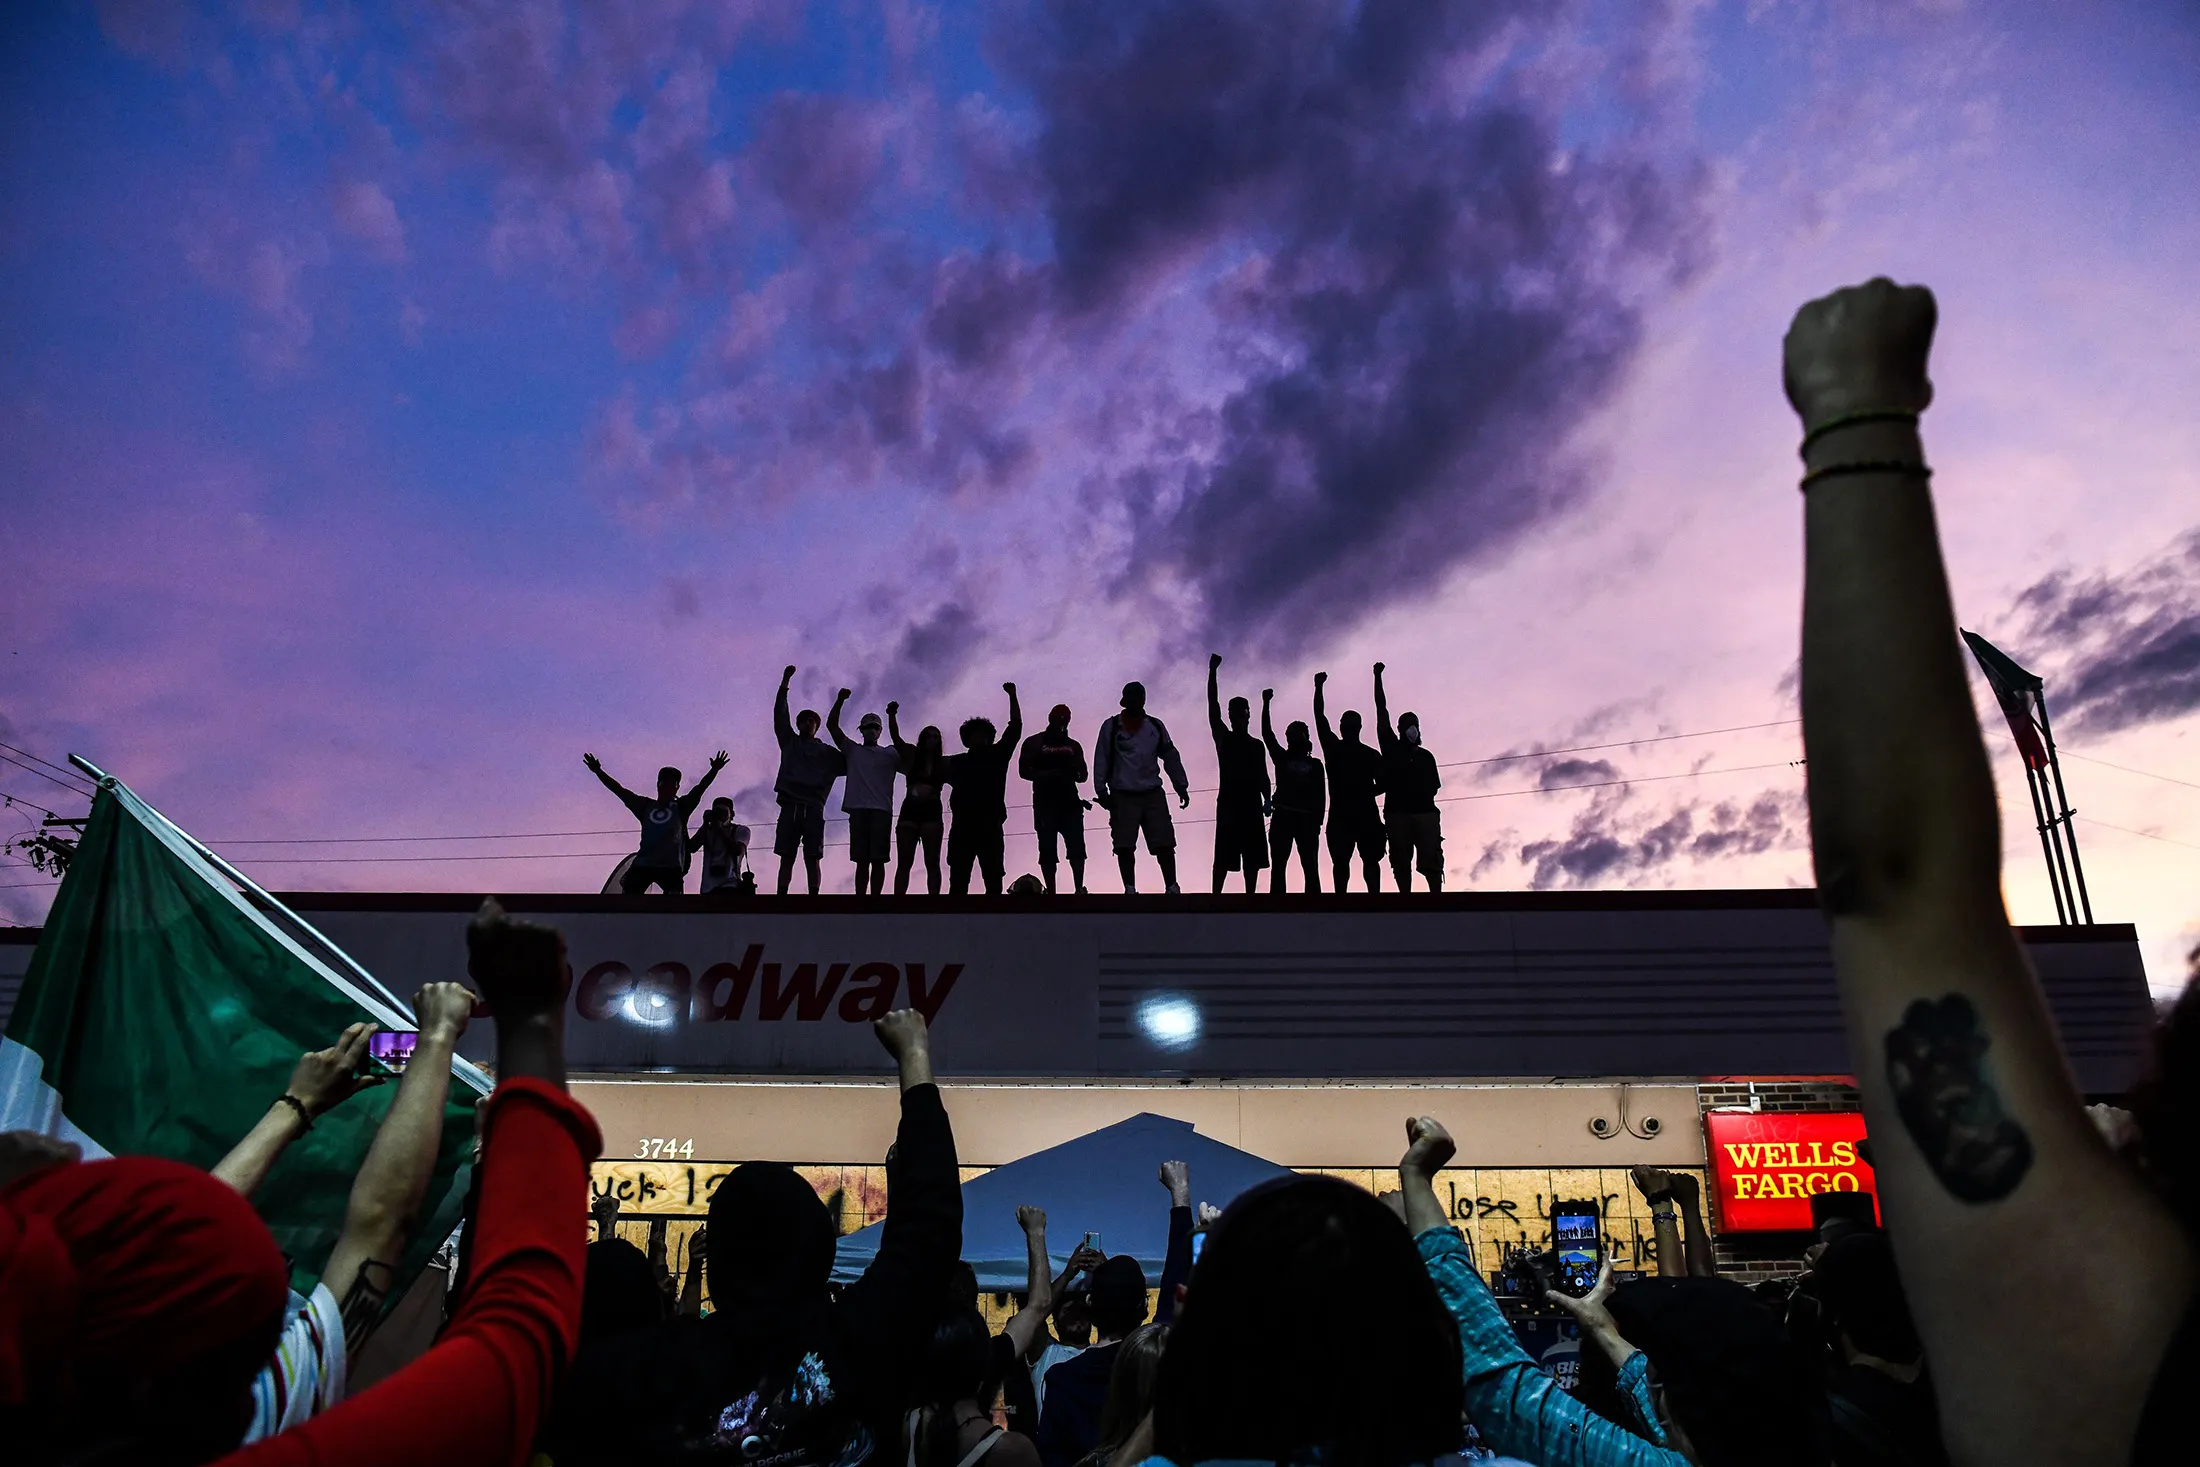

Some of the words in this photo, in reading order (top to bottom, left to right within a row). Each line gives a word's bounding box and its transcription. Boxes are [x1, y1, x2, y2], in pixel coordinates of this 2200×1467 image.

[470, 943, 966, 1029] eedway
[633, 1138, 695, 1160] 3744
[1723, 1141, 1856, 1168] WELLS
[588, 1172, 657, 1203] uck
[1731, 1171, 1860, 1199] FARGO
[1449, 1181, 1520, 1224] lose
